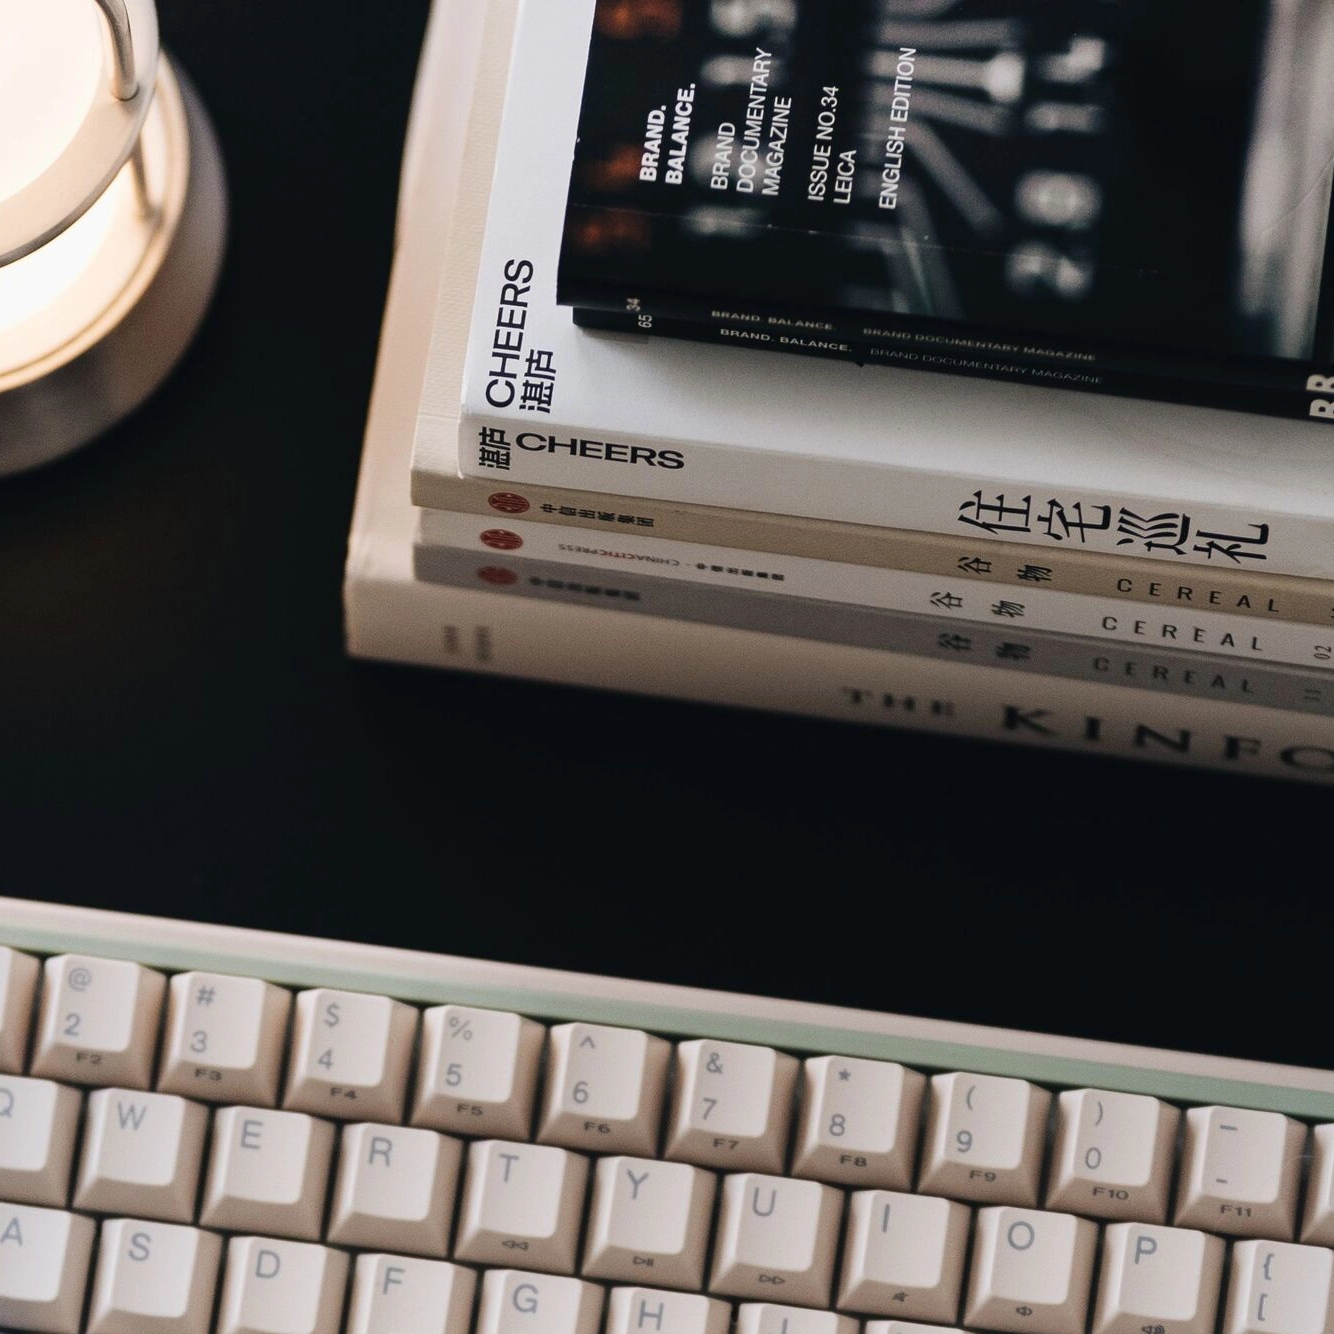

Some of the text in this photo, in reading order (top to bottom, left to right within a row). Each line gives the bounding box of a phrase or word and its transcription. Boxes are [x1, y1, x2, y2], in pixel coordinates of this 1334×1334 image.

[665, 83, 695, 184] BALANCE.
[737, 46, 773, 194] DOCUMENTARY
[878, 45, 917, 211] ENGLISH EDITION
[639, 105, 666, 181] BRAND.
[711, 121, 736, 191] BRAND
[762, 95, 793, 198] MAGAZINE
[808, 86, 839, 201] ISSUE NO.34
[833, 150, 856, 204] LEICA
[638, 315, 652, 328] 65
[711, 310, 836, 330] BRAND. BALANCE.
[485, 259, 535, 410] CHEERS
[720, 329, 851, 351] BRAND. BALANCE.
[863, 328, 1095, 361] BRAND DOCUMENTARY MAGAZINE
[870, 348, 1102, 383] BRAND DOCUMENTARY MAGAZINE
[519, 349, 556, 413] 湛庐
[479, 426, 511, 470] 湛庐
[516, 433, 684, 469] CHEERS
[958, 490, 1269, 563] 住宅巡礼
[957, 557, 1052, 582] 谷物
[1115, 577, 1281, 614] CEREAL
[930, 592, 1025, 618] 谷物
[1102, 616, 1262, 651] CEREAL
[1093, 657, 1254, 694] CEREAL
[67, 967, 92, 992] @
[196, 986, 215, 1006] #
[64, 1013, 81, 1036] 2
[324, 1002, 340, 1028] $
[448, 1016, 473, 1041] %
[190, 1030, 207, 1054] 3
[580, 1036, 596, 1049] ^
[75, 1050, 104, 1065] F2
[318, 1049, 333, 1070] 4
[706, 1052, 723, 1074] &
[194, 1067, 223, 1081] F3
[445, 1063, 462, 1087] 5
[330, 1086, 357, 1100] F4
[572, 1081, 589, 1104] 6
[966, 1085, 975, 1110] (
[117, 1102, 147, 1131] W
[456, 1102, 484, 1116] F5
[703, 1097, 718, 1120] 7
[1095, 1101, 1103, 1126] )
[240, 1119, 263, 1150] E
[583, 1119, 611, 1134] F6
[829, 1113, 846, 1137] 8
[368, 1136, 393, 1167] R
[713, 1137, 740, 1150] F7
[956, 1130, 973, 1153] 9
[499, 1153, 520, 1183] T
[840, 1154, 867, 1167] F8
[627, 1169, 649, 1200] Y
[969, 1169, 997, 1182] F9
[752, 1187, 776, 1217] U
[1092, 1186, 1129, 1200] F10
[882, 1204, 890, 1233] I
[1220, 1204, 1251, 1217] F11
[0, 1217, 23, 1246] A
[1007, 1221, 1035, 1251] O
[128, 1232, 151, 1262] S
[1134, 1236, 1157, 1264] P
[255, 1249, 281, 1279] D
[1263, 1253, 1274, 1281] {
[383, 1266, 405, 1295] F
[512, 1284, 538, 1314] G
[1257, 1293, 1268, 1321] [
[638, 1300, 664, 1331] H
